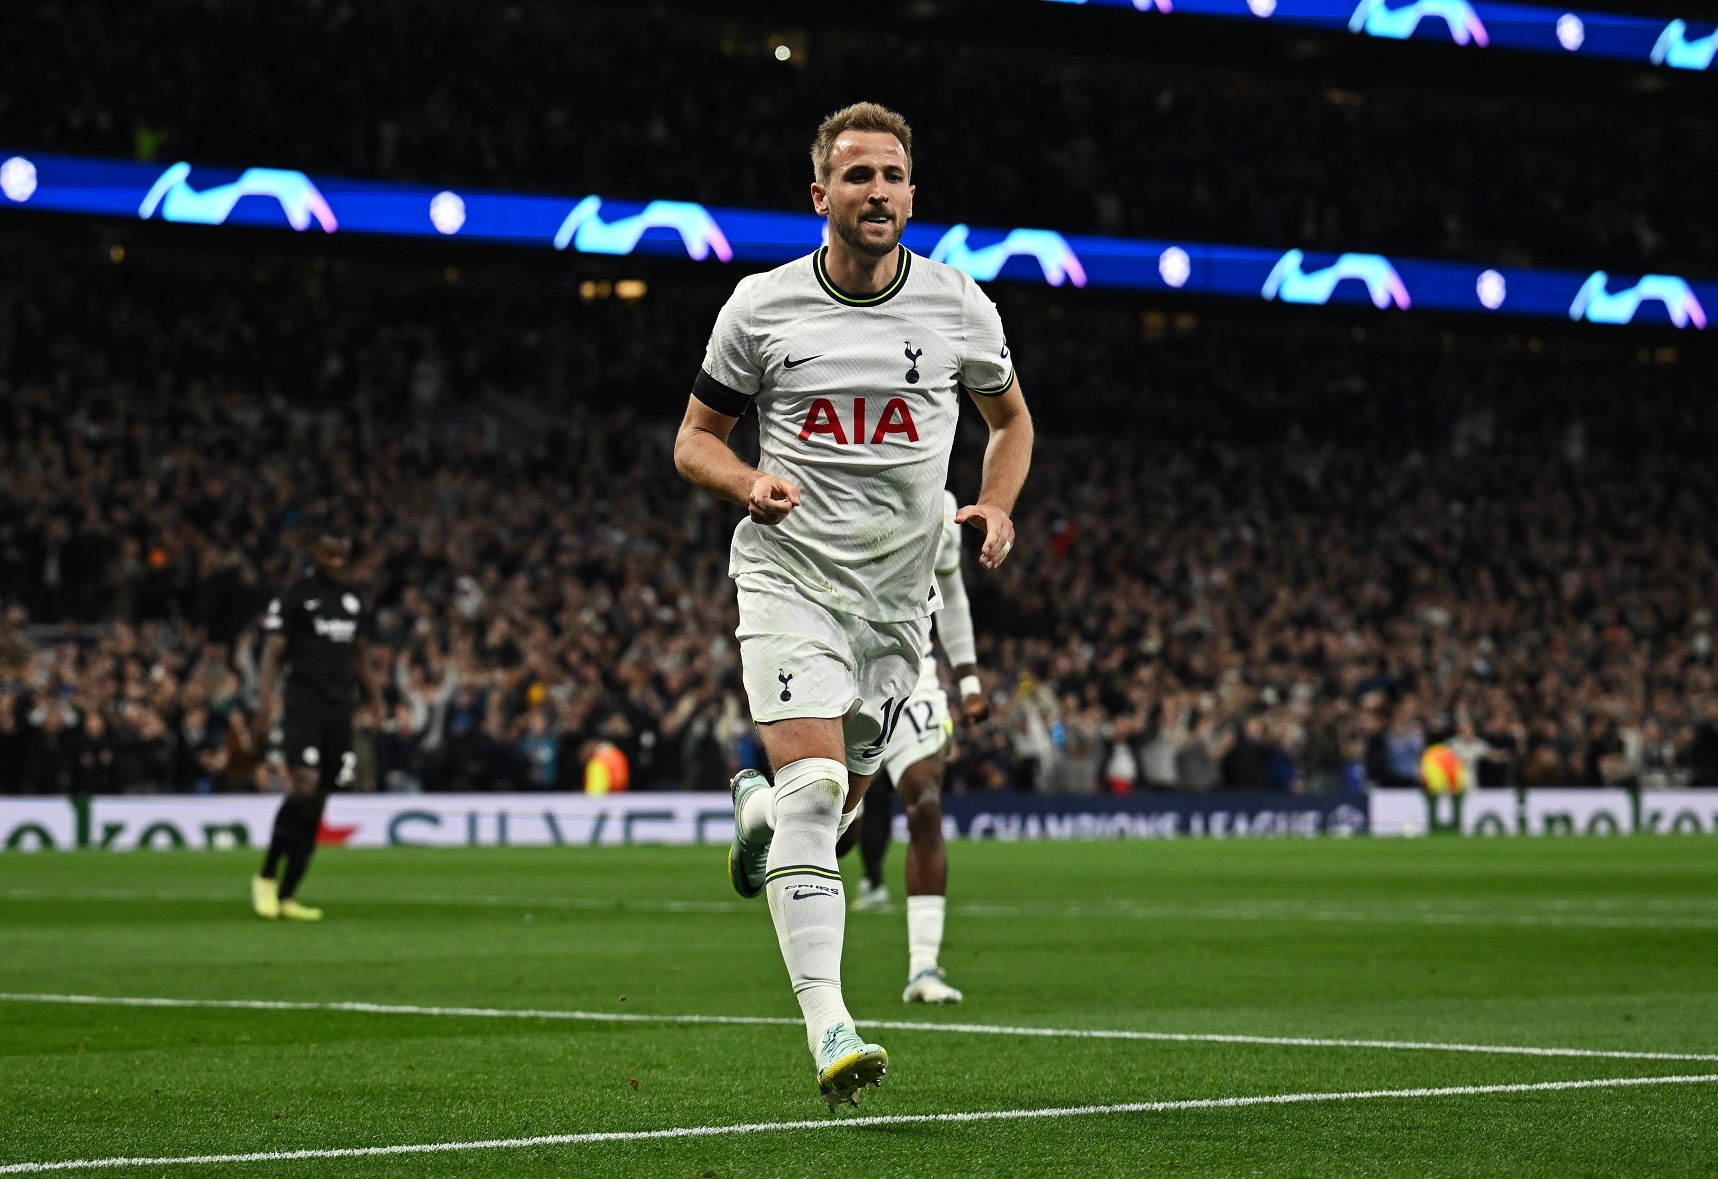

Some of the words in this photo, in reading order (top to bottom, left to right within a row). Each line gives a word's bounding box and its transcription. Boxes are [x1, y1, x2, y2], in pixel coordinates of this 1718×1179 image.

[798, 397, 920, 445] AIA
[903, 700, 940, 734] 12
[1189, 809, 1323, 839] LEAGUE
